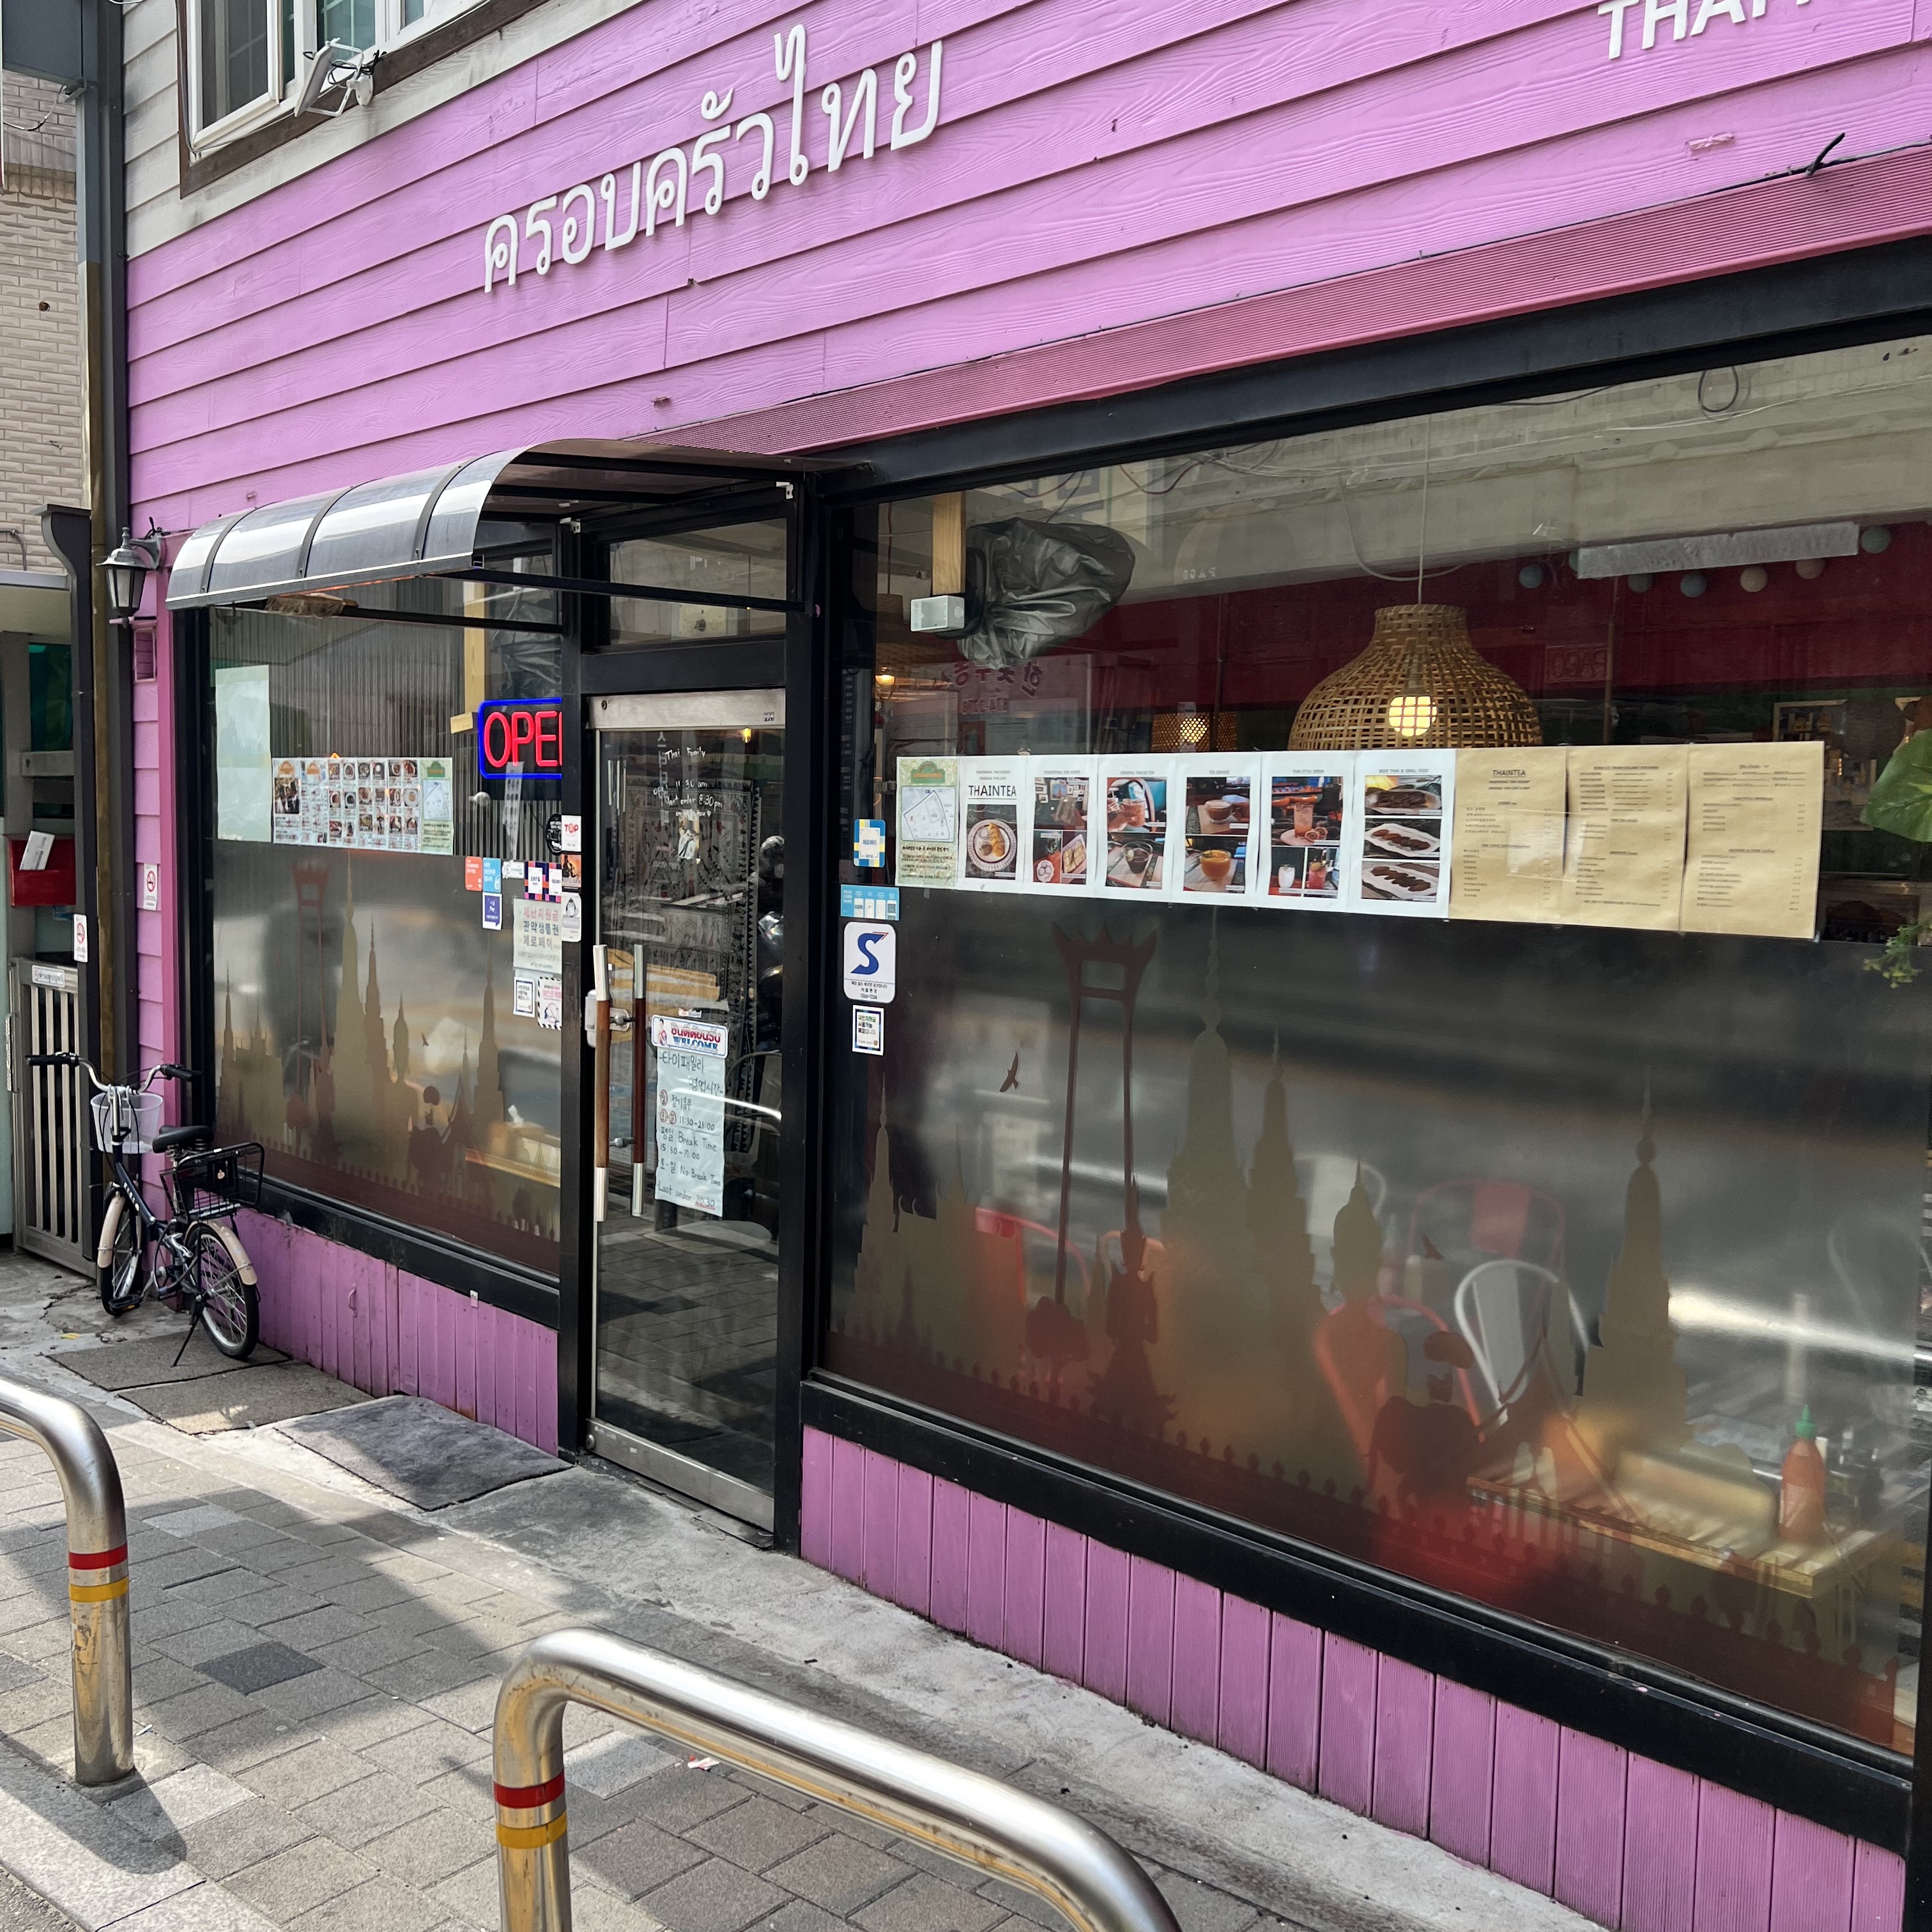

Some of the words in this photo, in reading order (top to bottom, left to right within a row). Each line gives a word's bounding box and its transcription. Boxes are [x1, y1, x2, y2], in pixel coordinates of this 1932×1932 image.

[483, 23, 944, 293] ครอบครัวไทย
[484, 710, 563, 769] OPE
[968, 785, 1017, 797] THAINTEA
[523, 906, 558, 921] 재난지원금
[523, 921, 559, 936] 관악상품권
[523, 935, 553, 949] 제로페이
[673, 1036, 718, 1052] WELCOME
[671, 1094, 692, 1112] 정기휴무
[678, 1131, 699, 1147] Break
[702, 1137, 717, 1152] Time
[680, 1165, 689, 1176] No
[691, 1168, 707, 1181] Break
[675, 1189, 692, 1201] order
[696, 1194, 716, 1207] 20:30
